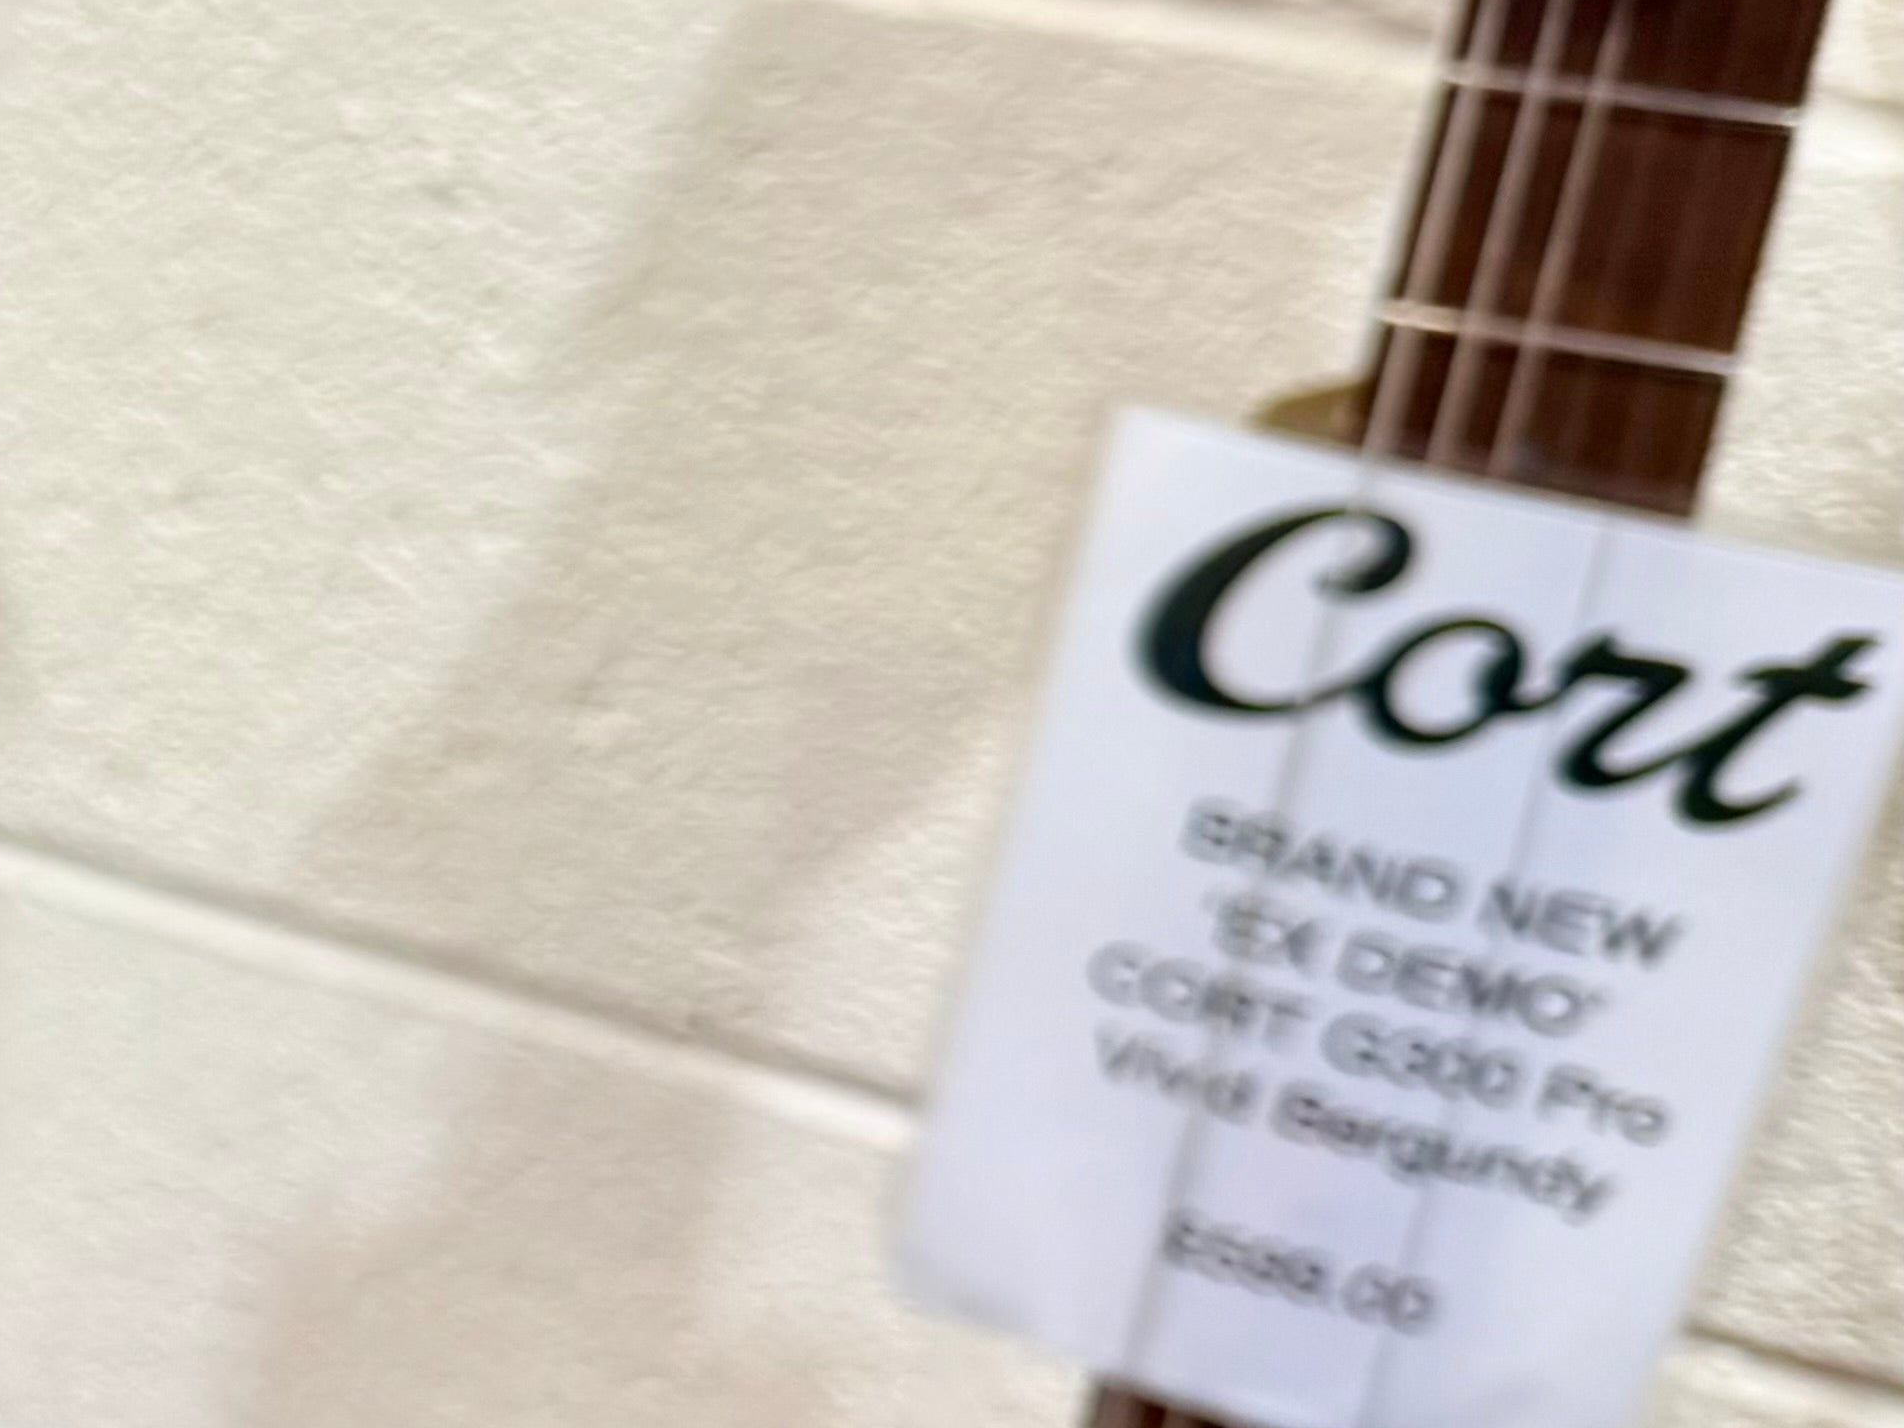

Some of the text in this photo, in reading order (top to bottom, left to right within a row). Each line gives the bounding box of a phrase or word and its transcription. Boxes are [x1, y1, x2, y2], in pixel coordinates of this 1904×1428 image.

[1133, 502, 1884, 830] Cort
[1180, 800, 1684, 968] BRAND NEW
[1085, 941, 1312, 1050] CORT
[1537, 1064, 1669, 1146] Pro
[1092, 1020, 1256, 1125] Vivid
